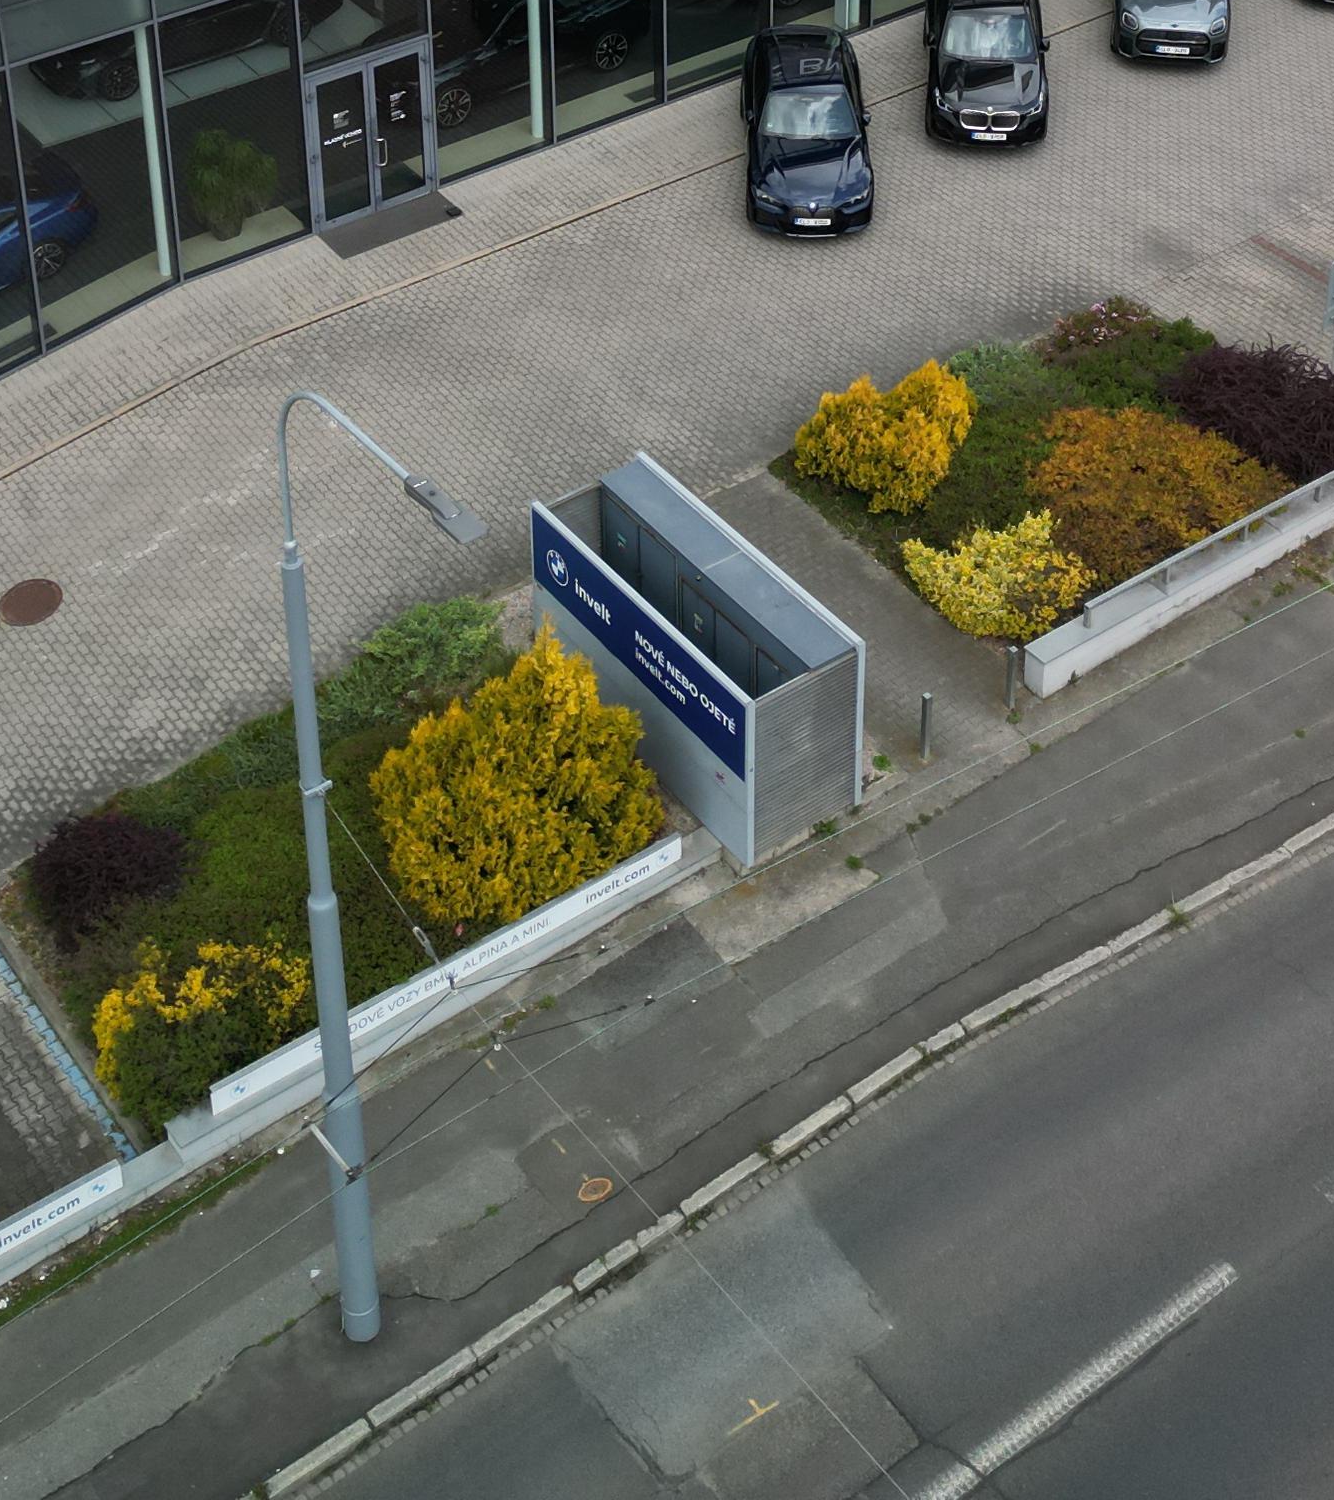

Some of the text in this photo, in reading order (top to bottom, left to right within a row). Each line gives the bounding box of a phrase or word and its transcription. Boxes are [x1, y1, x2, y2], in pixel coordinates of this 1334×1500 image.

[574, 577, 611, 626] invelt
[634, 630, 736, 735] NOVÉ NEBO OJETÉ
[635, 647, 686, 705] invelt.com
[585, 865, 650, 904] invelt.com
[387, 986, 421, 1011] VOZY
[463, 941, 509, 972] ALPINA
[510, 934, 520, 946] A
